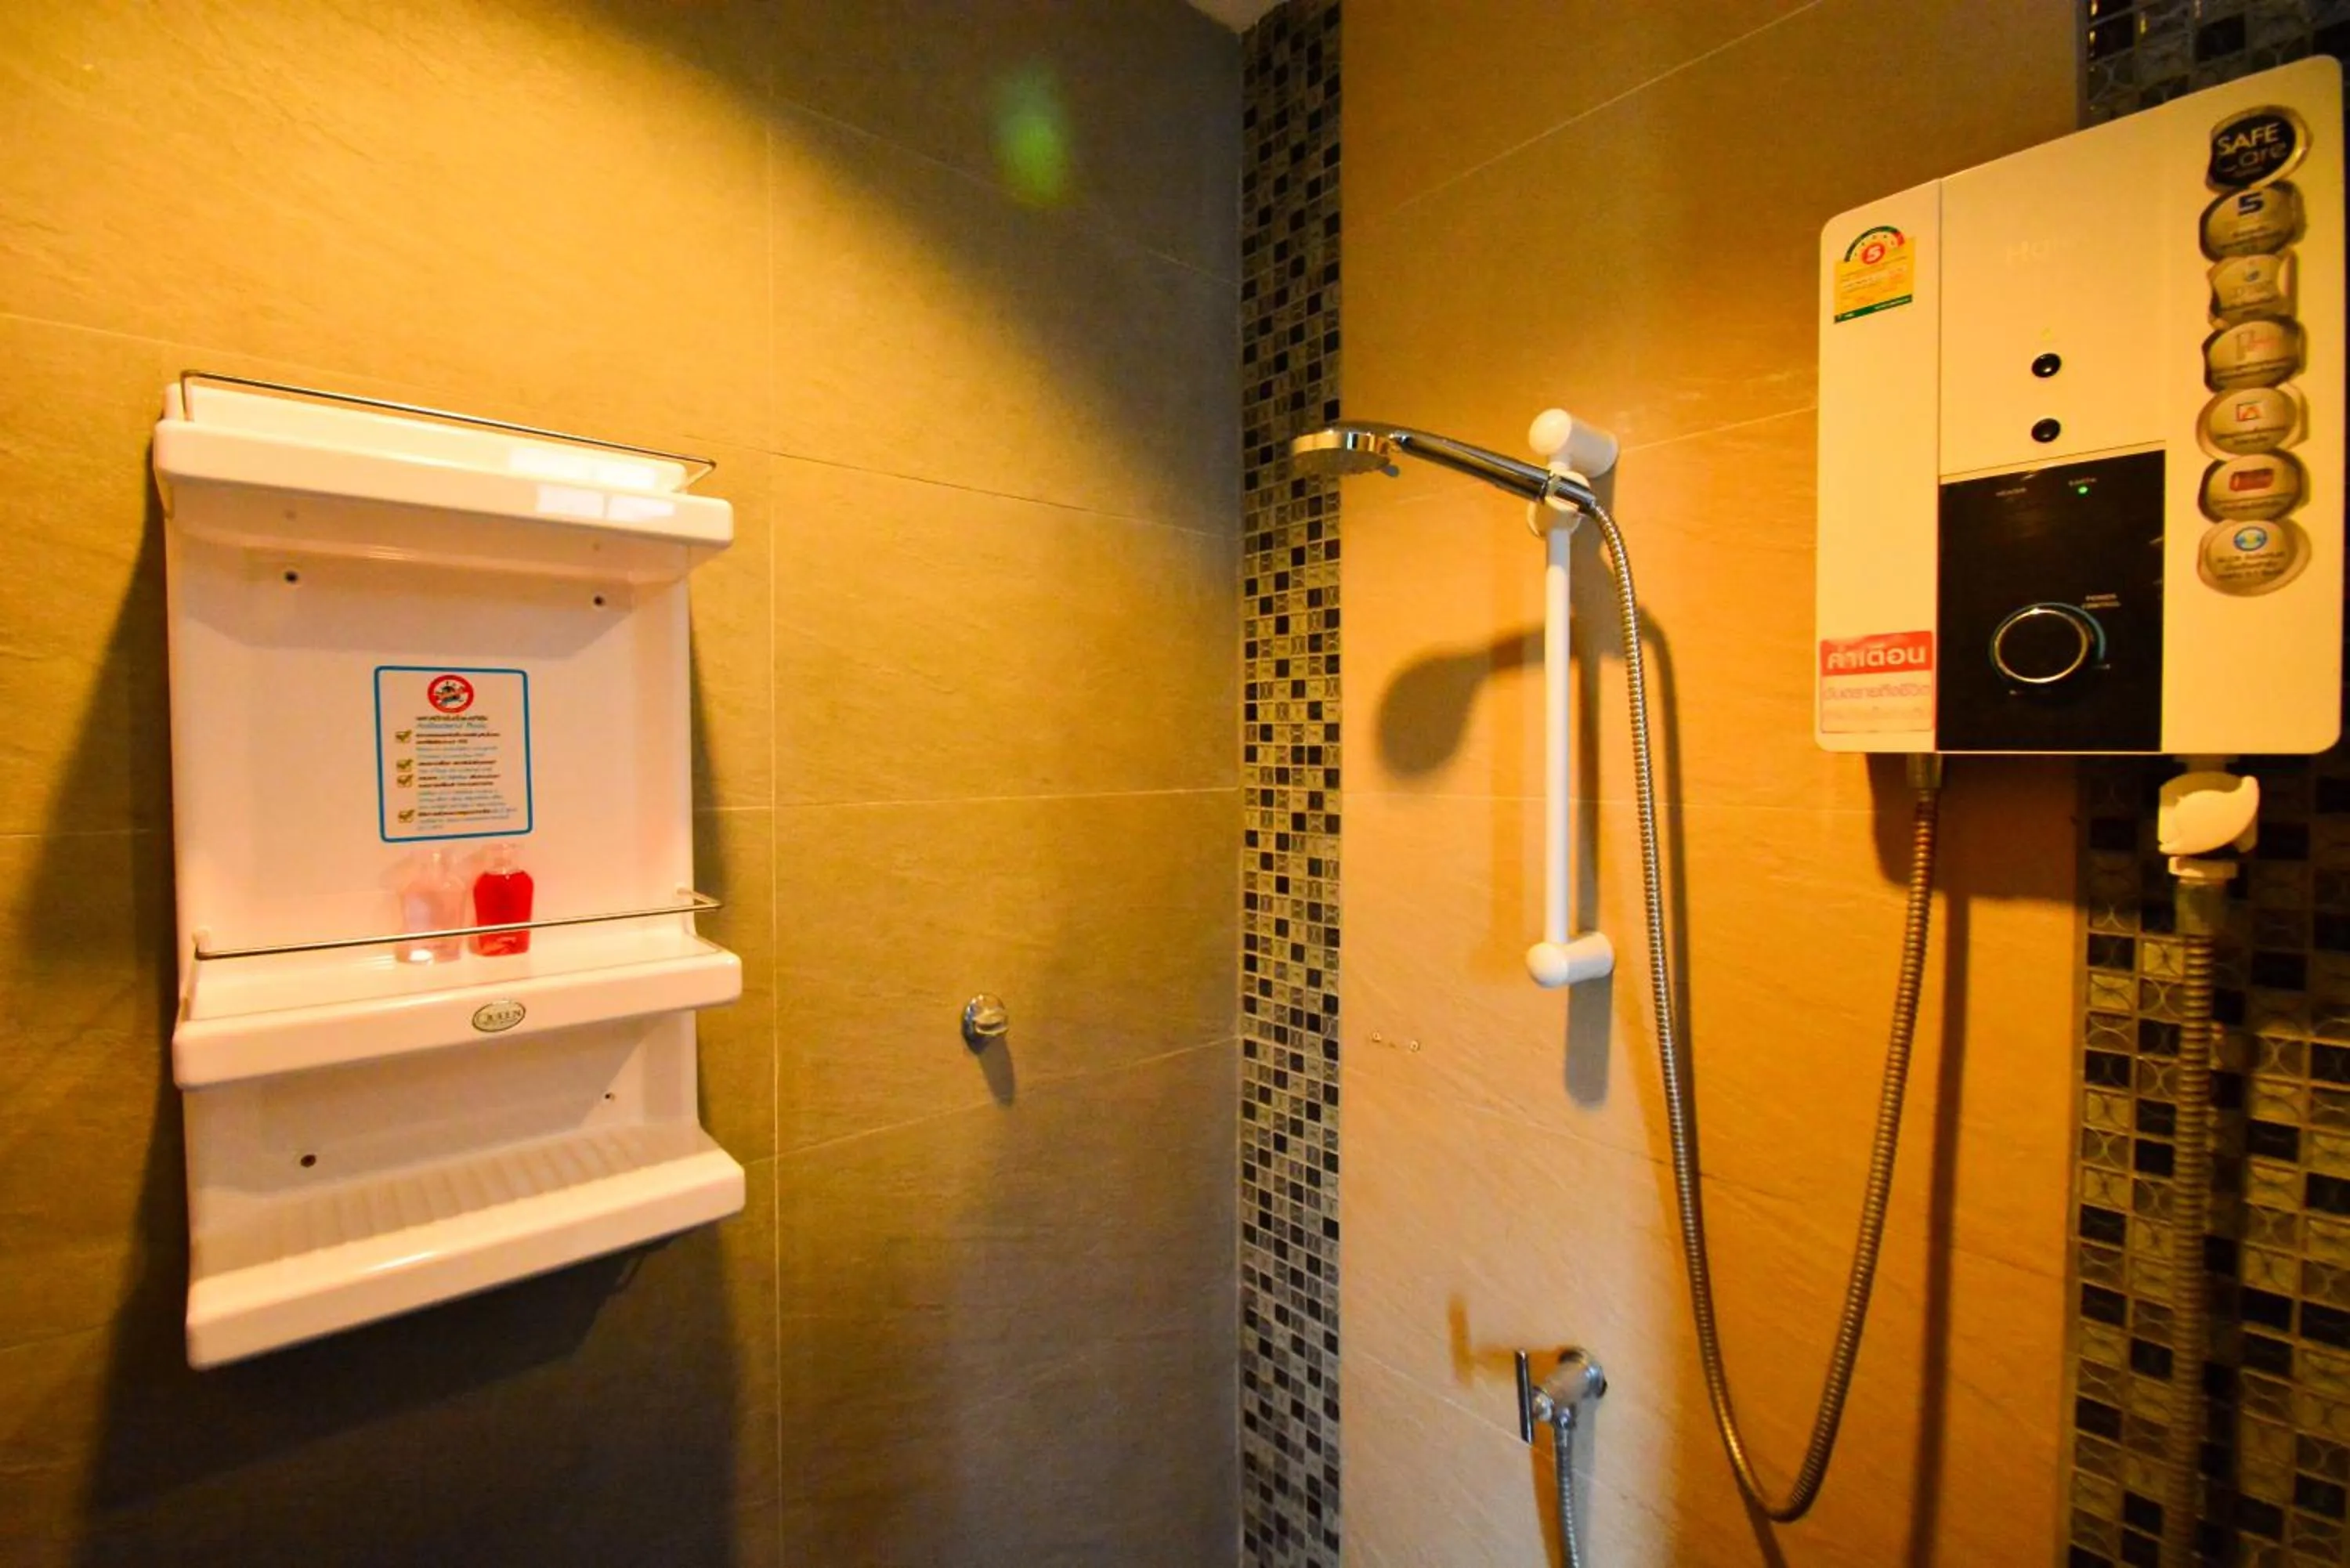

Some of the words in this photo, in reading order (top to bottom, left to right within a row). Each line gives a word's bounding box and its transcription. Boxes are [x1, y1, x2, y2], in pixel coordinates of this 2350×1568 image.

[2218, 121, 2280, 156] SAFE
[2238, 192, 2264, 216] 5
[1827, 642, 1927, 670] คำเตือน
